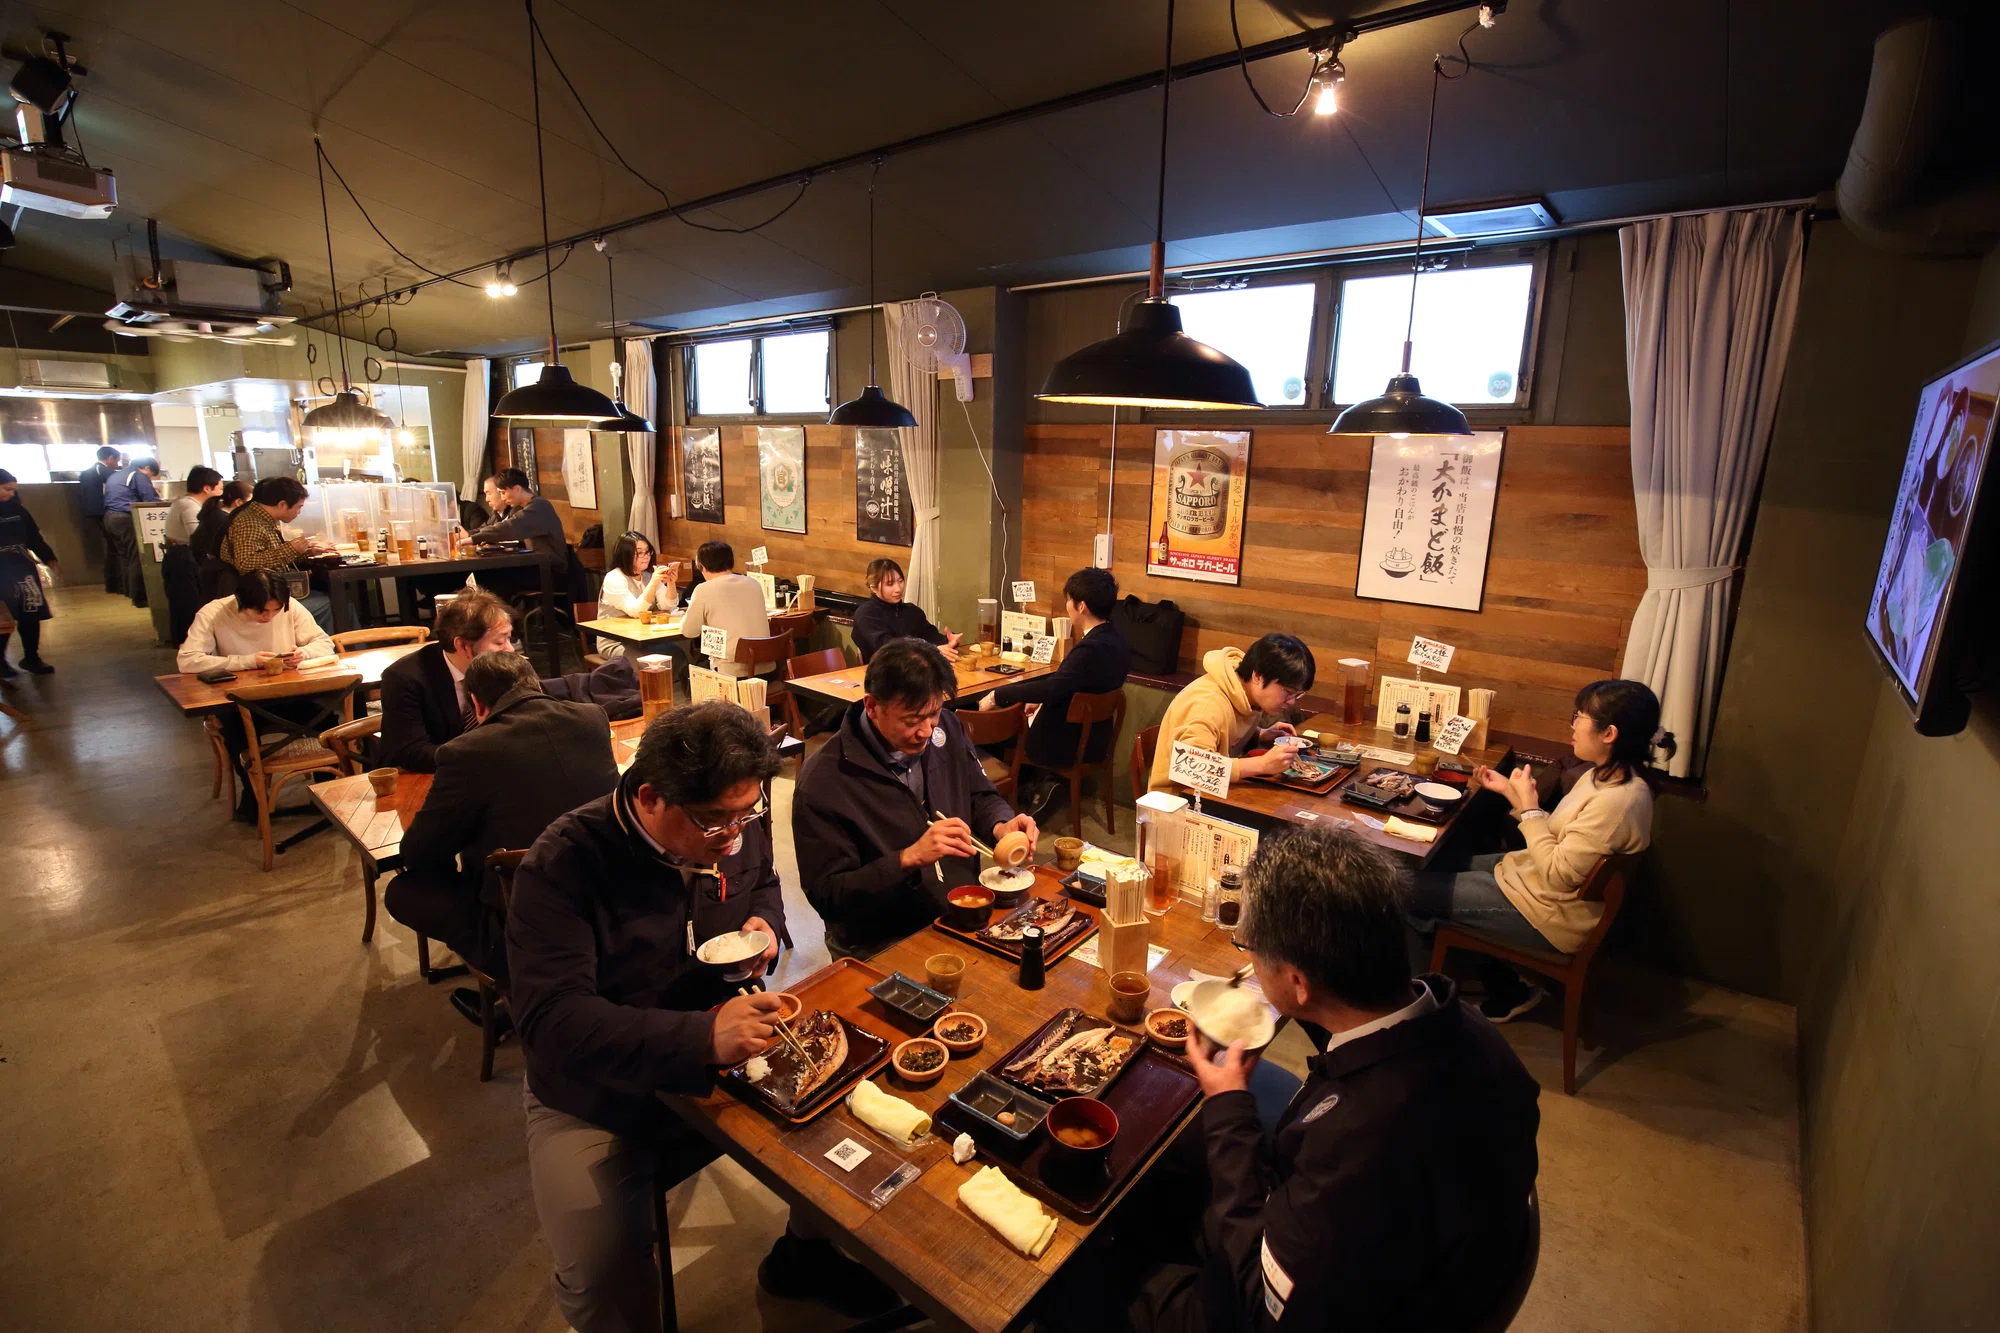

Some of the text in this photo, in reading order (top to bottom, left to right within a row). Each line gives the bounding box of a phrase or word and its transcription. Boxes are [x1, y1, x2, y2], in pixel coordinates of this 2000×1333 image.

[1176, 494, 1217, 507] SAPPORO
[1447, 453, 1474, 585] 御飯は、当店自慢の炊きたて
[1169, 556, 1195, 568] サッポロ
[1196, 560, 1236, 574] ラガービール
